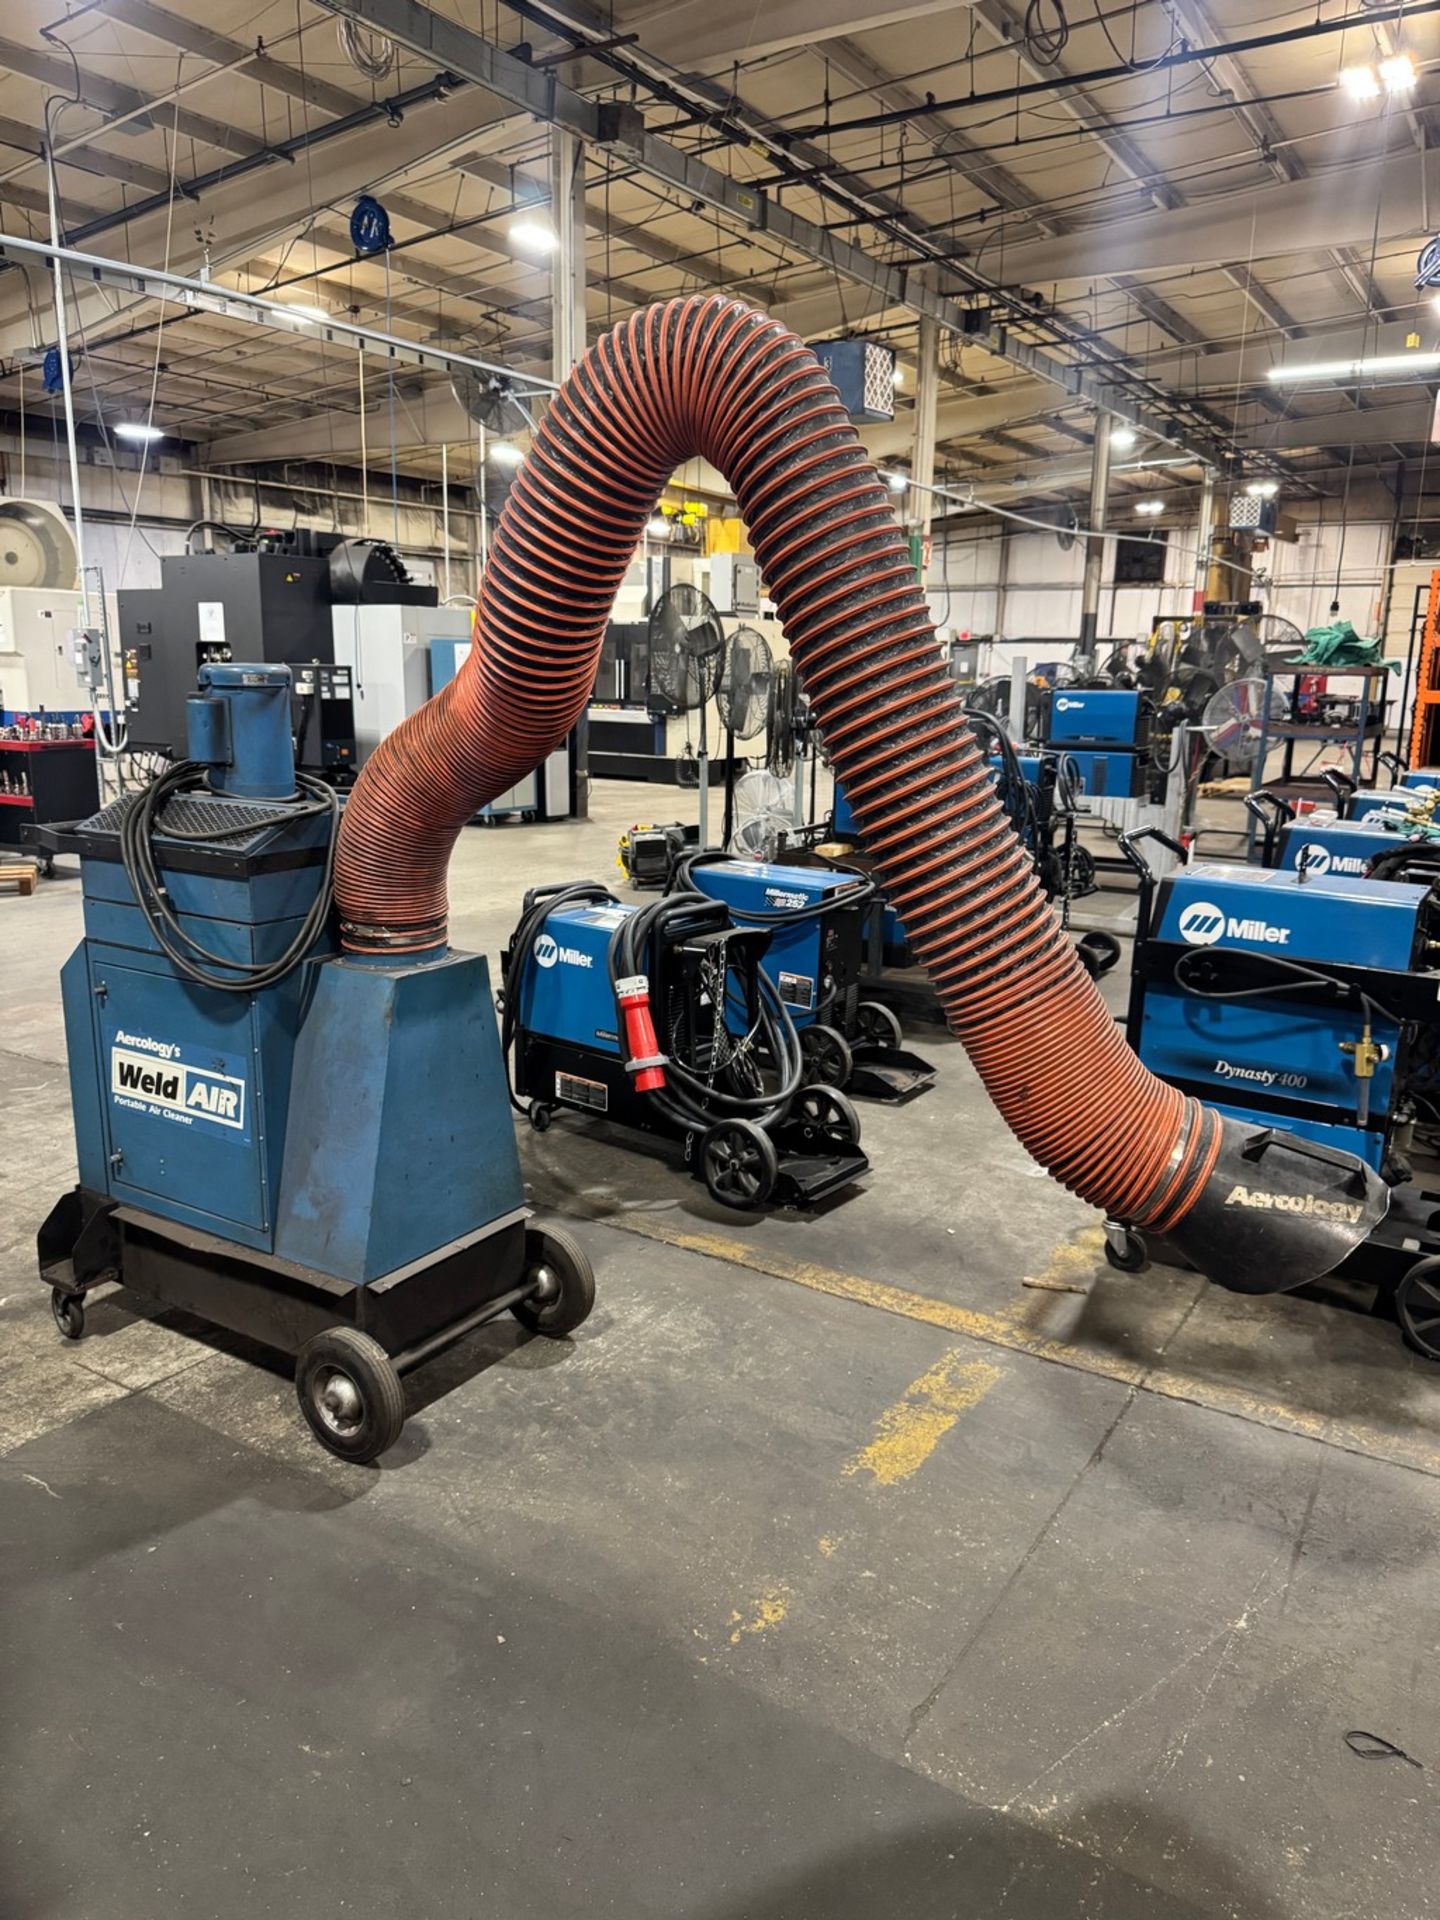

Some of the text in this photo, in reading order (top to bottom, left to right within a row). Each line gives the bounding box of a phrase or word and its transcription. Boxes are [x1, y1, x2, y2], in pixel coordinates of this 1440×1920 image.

[1332, 856, 1368, 874] Mille
[1226, 919, 1291, 944] Miller
[559, 947, 593, 968] Miller
[115, 1030, 181, 1059] Aercology's
[1214, 1060, 1307, 1089] Dynasty 400
[119, 1062, 239, 1118] Weld AIR
[114, 1095, 193, 1125] Portable Air Cleaner
[1224, 1185, 1363, 1223] Aercology
